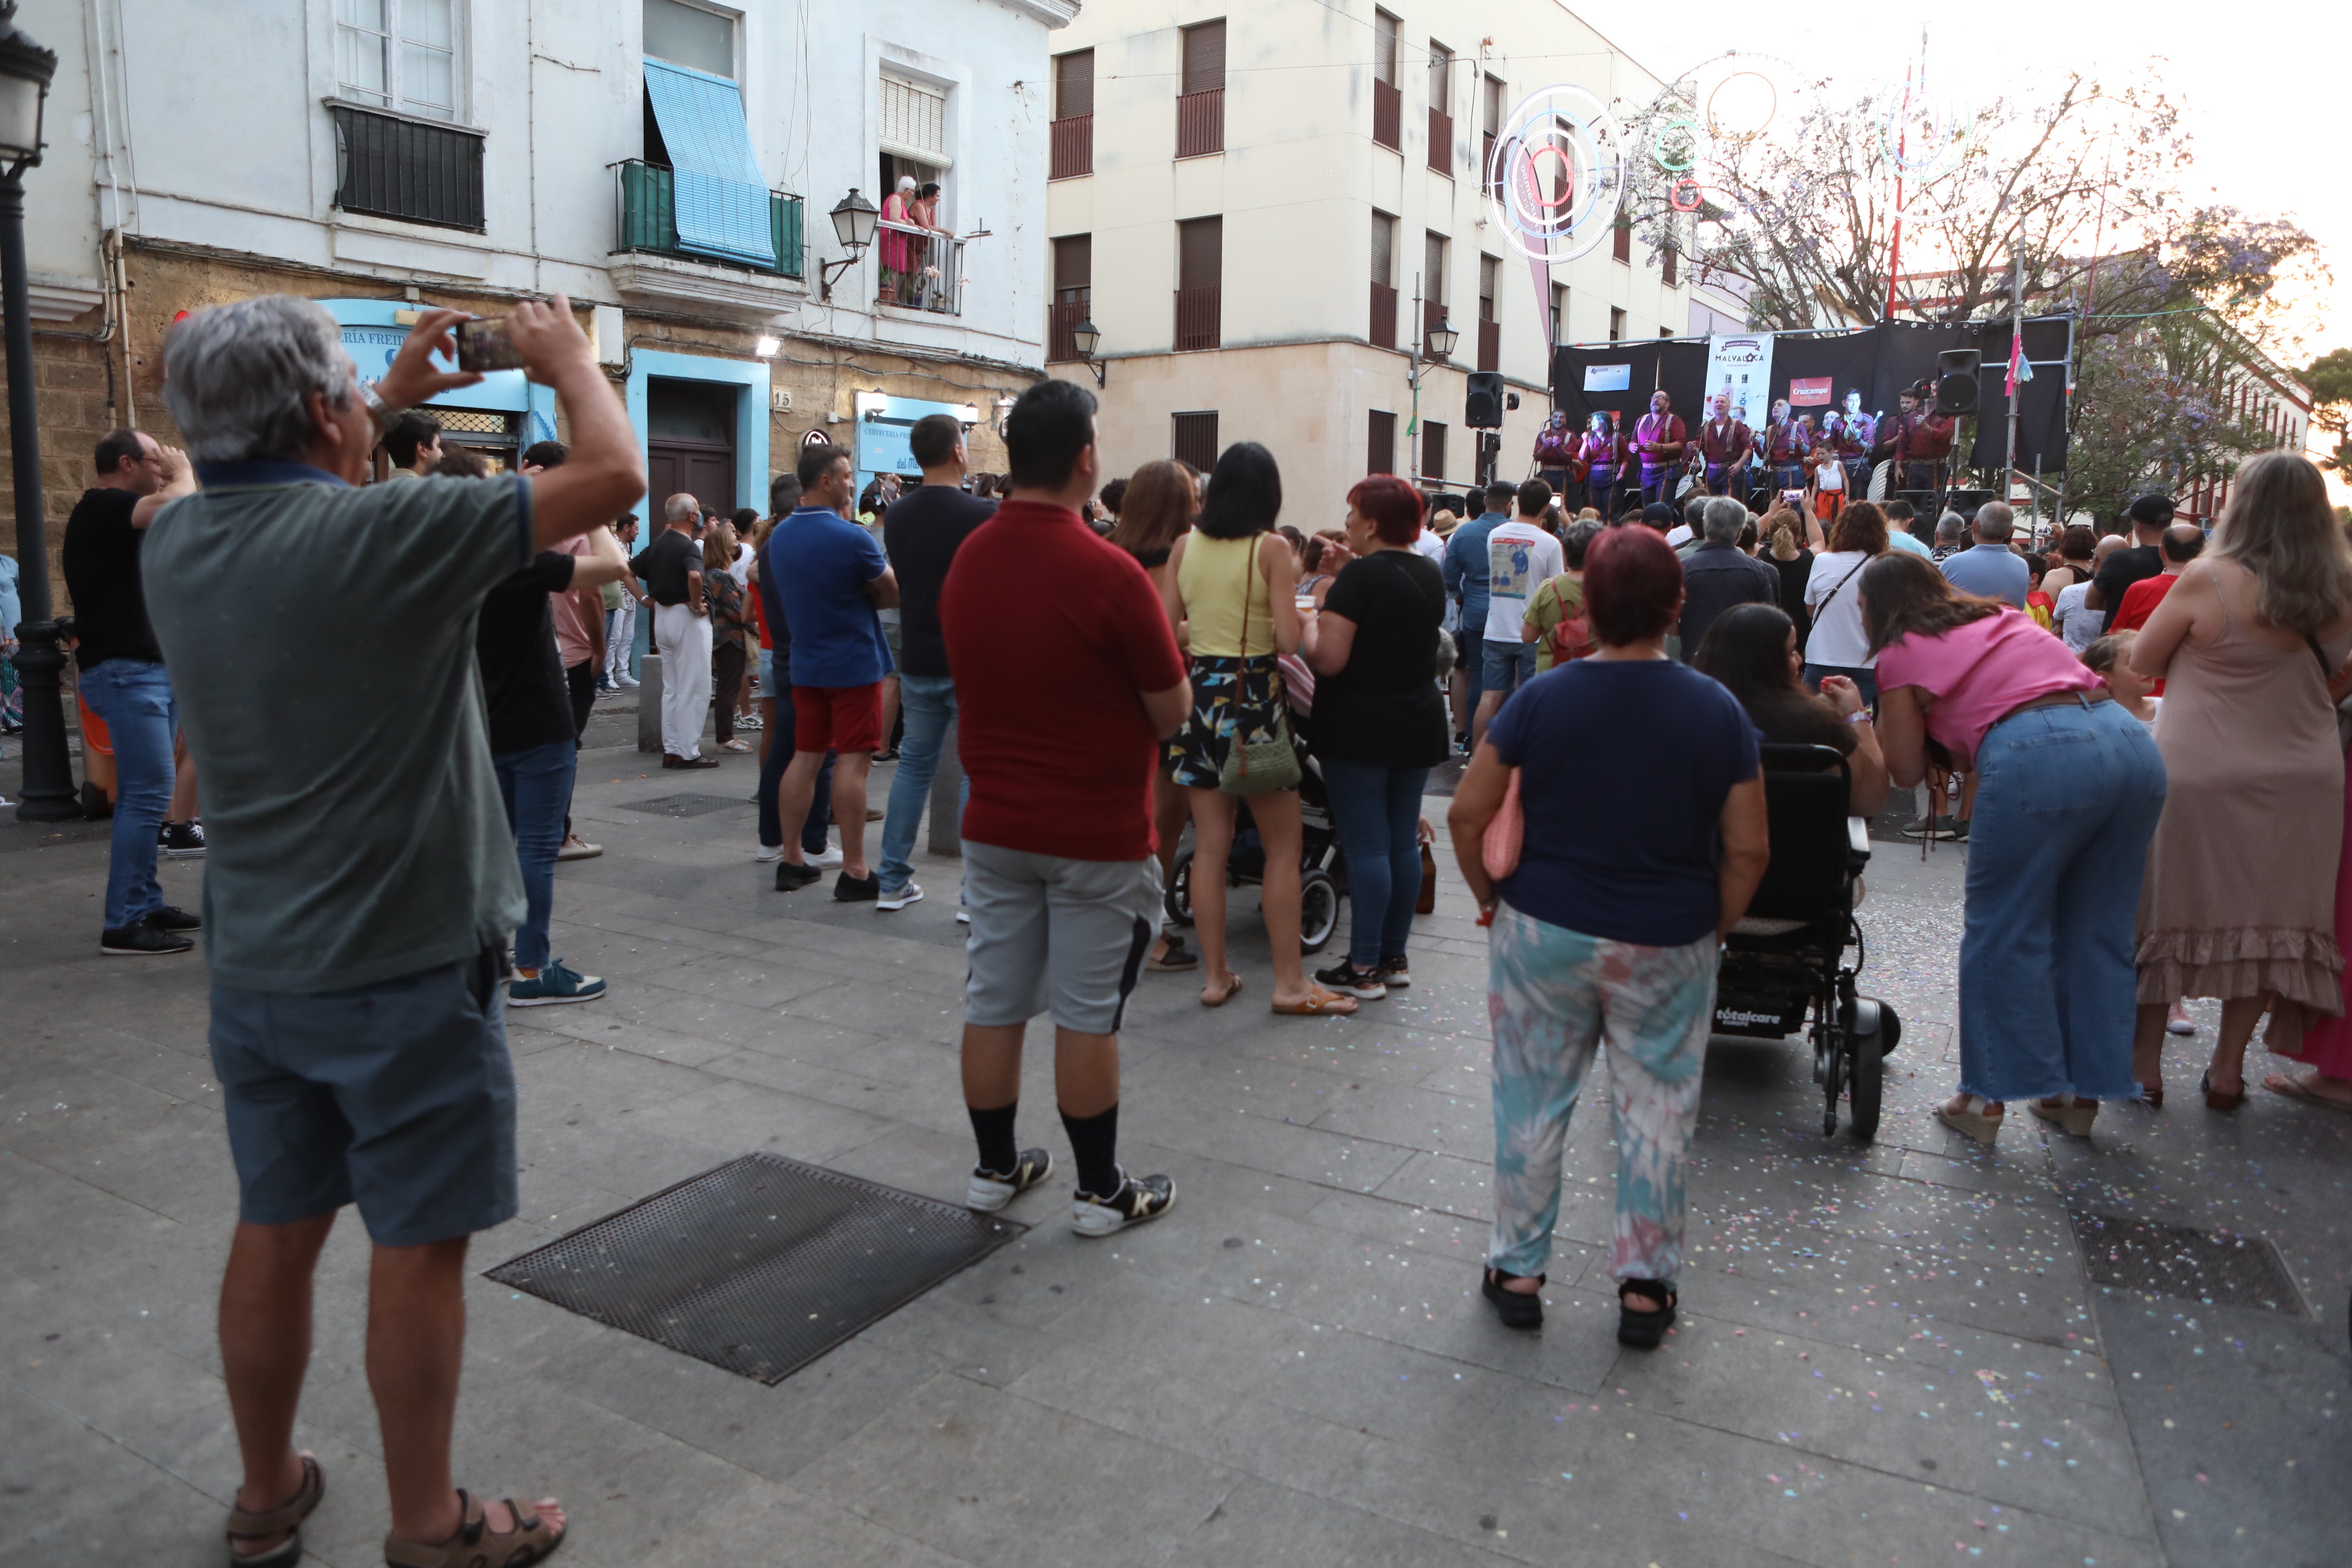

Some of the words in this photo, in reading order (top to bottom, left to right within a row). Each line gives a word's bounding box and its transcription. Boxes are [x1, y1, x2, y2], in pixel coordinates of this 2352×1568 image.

[368, 332, 406, 346] FREID
[1715, 354, 1764, 362] MALVALOCA
[775, 392, 790, 406] 15
[865, 428, 898, 438] CERVECERÍA
[897, 457, 907, 469] del
[908, 457, 920, 469] Me
[1717, 1007, 1781, 1024] totalcare
